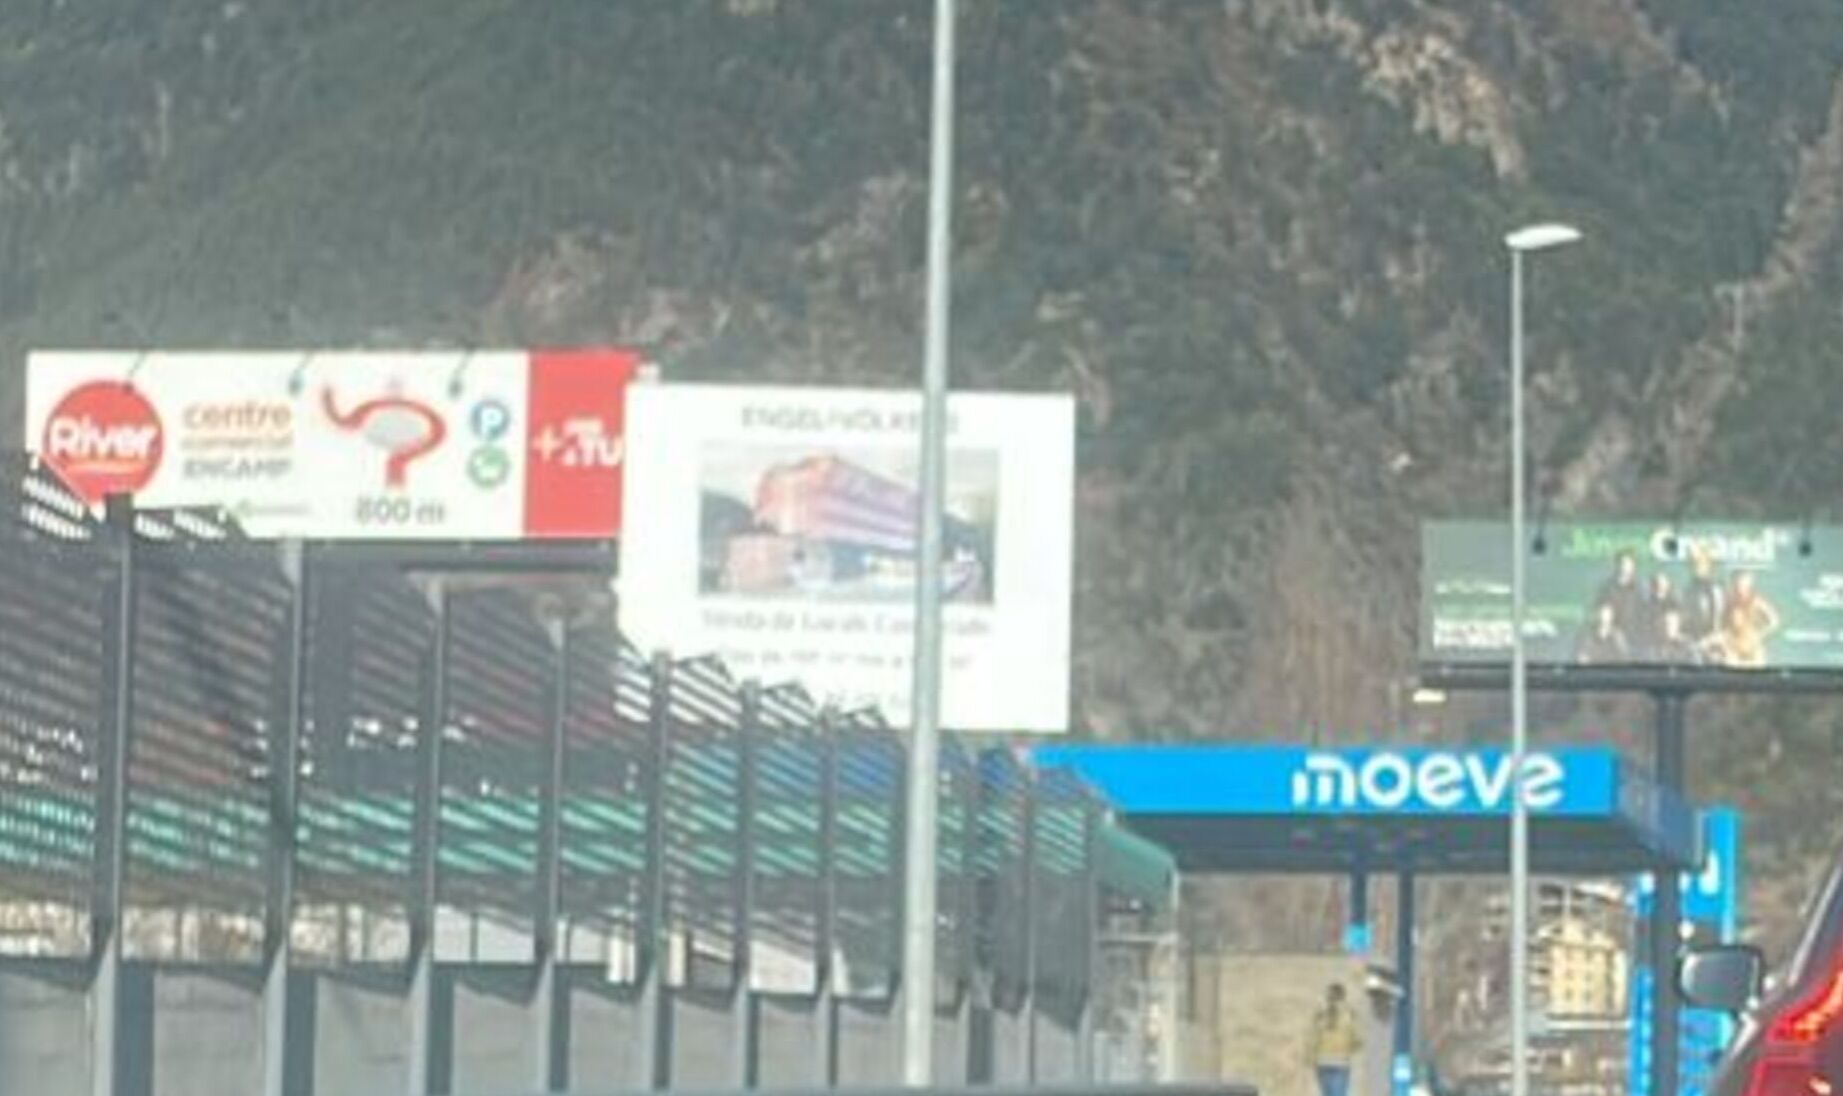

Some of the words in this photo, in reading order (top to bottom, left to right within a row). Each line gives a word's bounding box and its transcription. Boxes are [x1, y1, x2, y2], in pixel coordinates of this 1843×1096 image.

[183, 400, 292, 430] centre
[49, 414, 159, 461] River
[356, 497, 411, 525] 800
[1291, 751, 1564, 806] moeve
